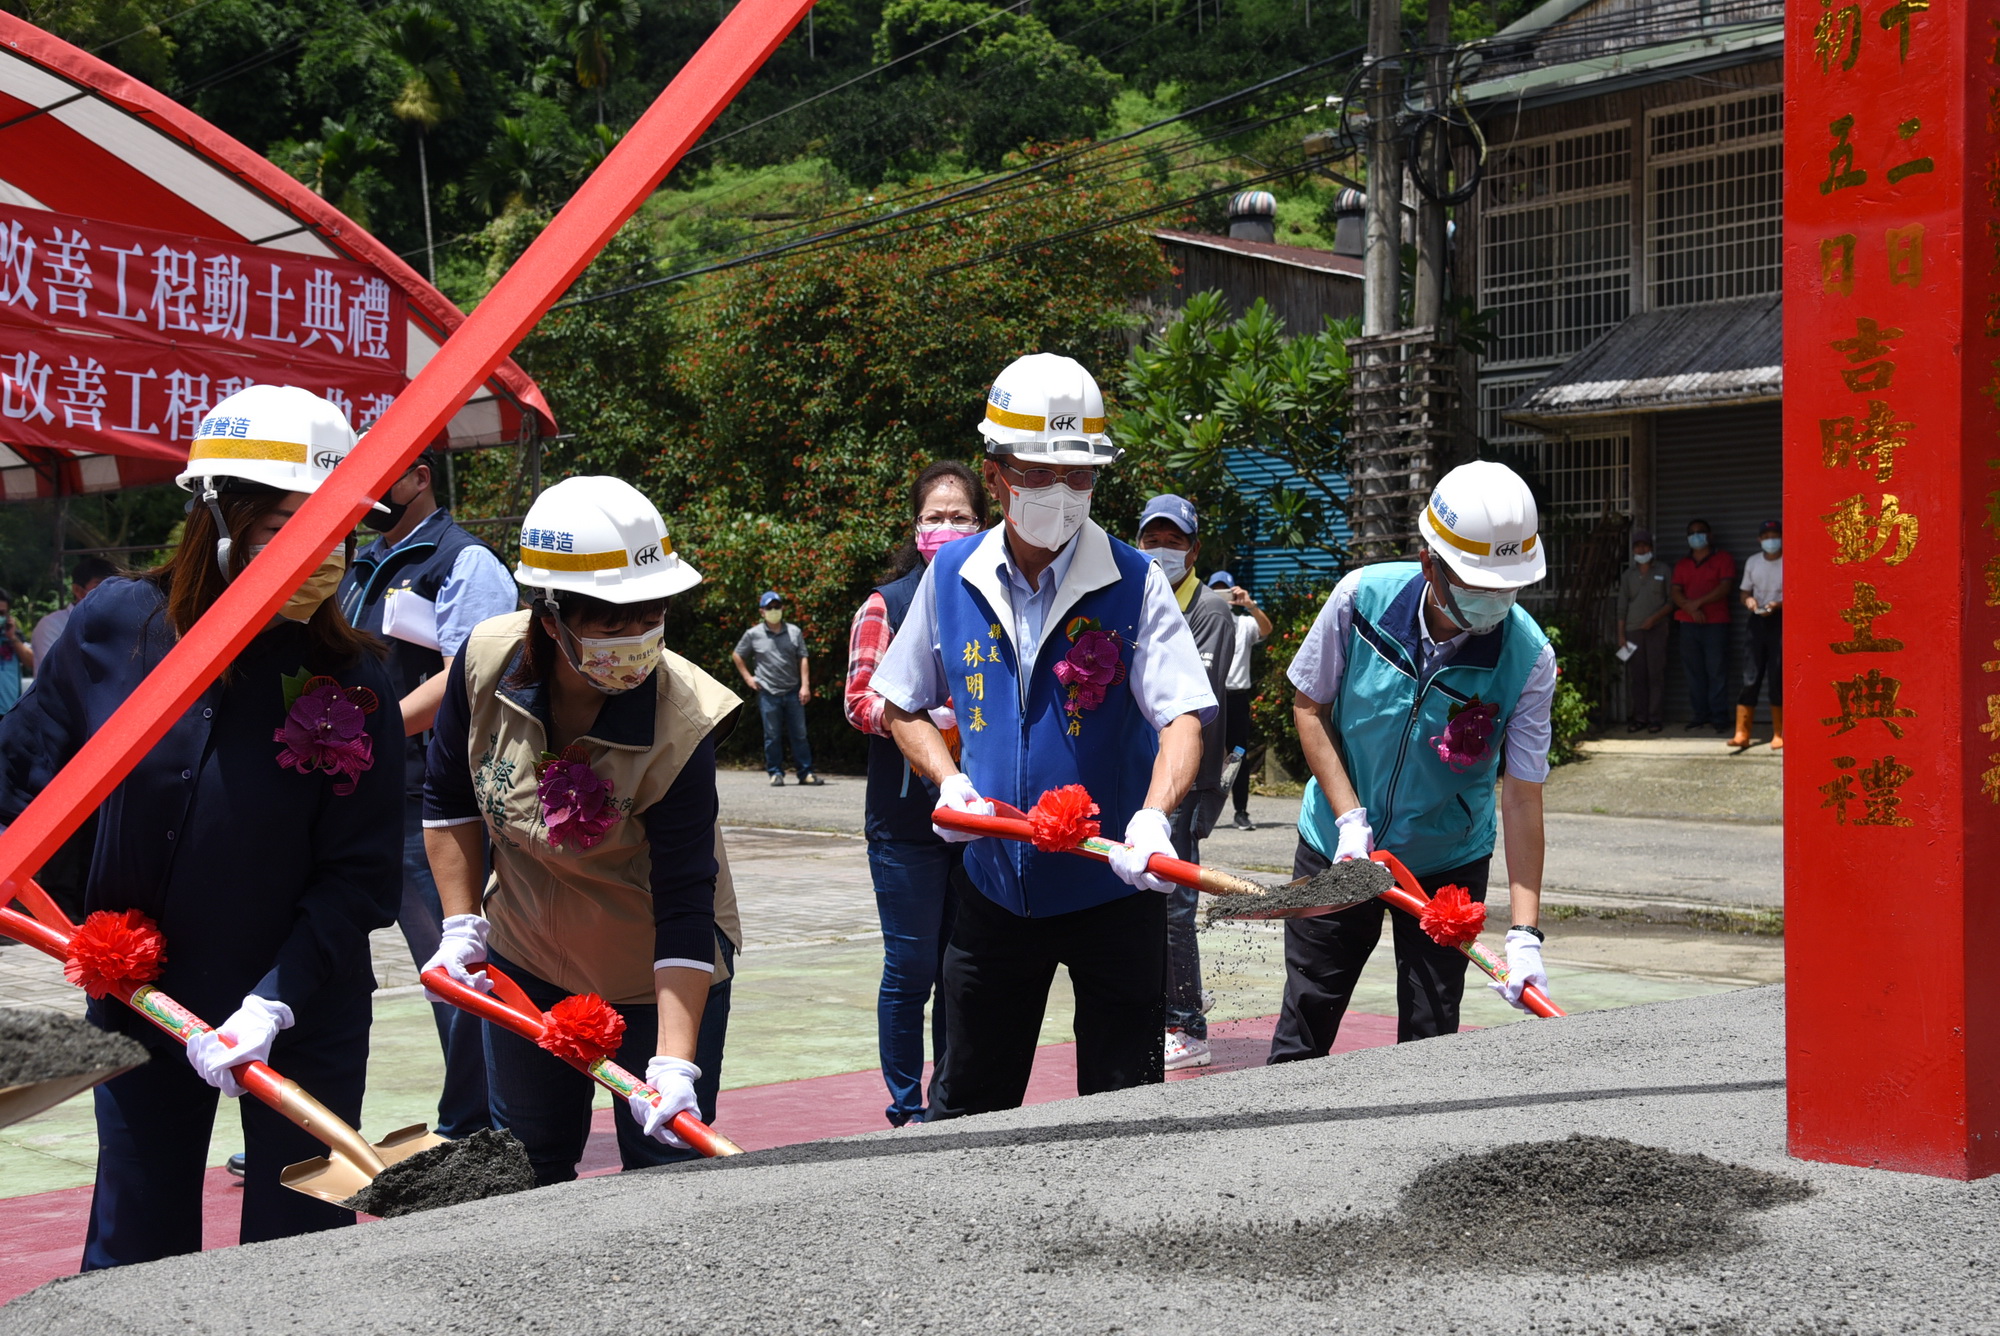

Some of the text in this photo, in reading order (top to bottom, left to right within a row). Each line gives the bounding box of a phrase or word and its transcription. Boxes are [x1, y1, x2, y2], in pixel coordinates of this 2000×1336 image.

[1813, 0, 1867, 297] 初五日
[0, 219, 391, 359] 改善工程動土典禮
[0, 350, 396, 440] 改善工程
[194, 416, 251, 440] 庫營造
[1818, 317, 1918, 827] 吉時動土典禮
[962, 639, 988, 732] 林明溱
[987, 624, 1002, 663] 縣長
